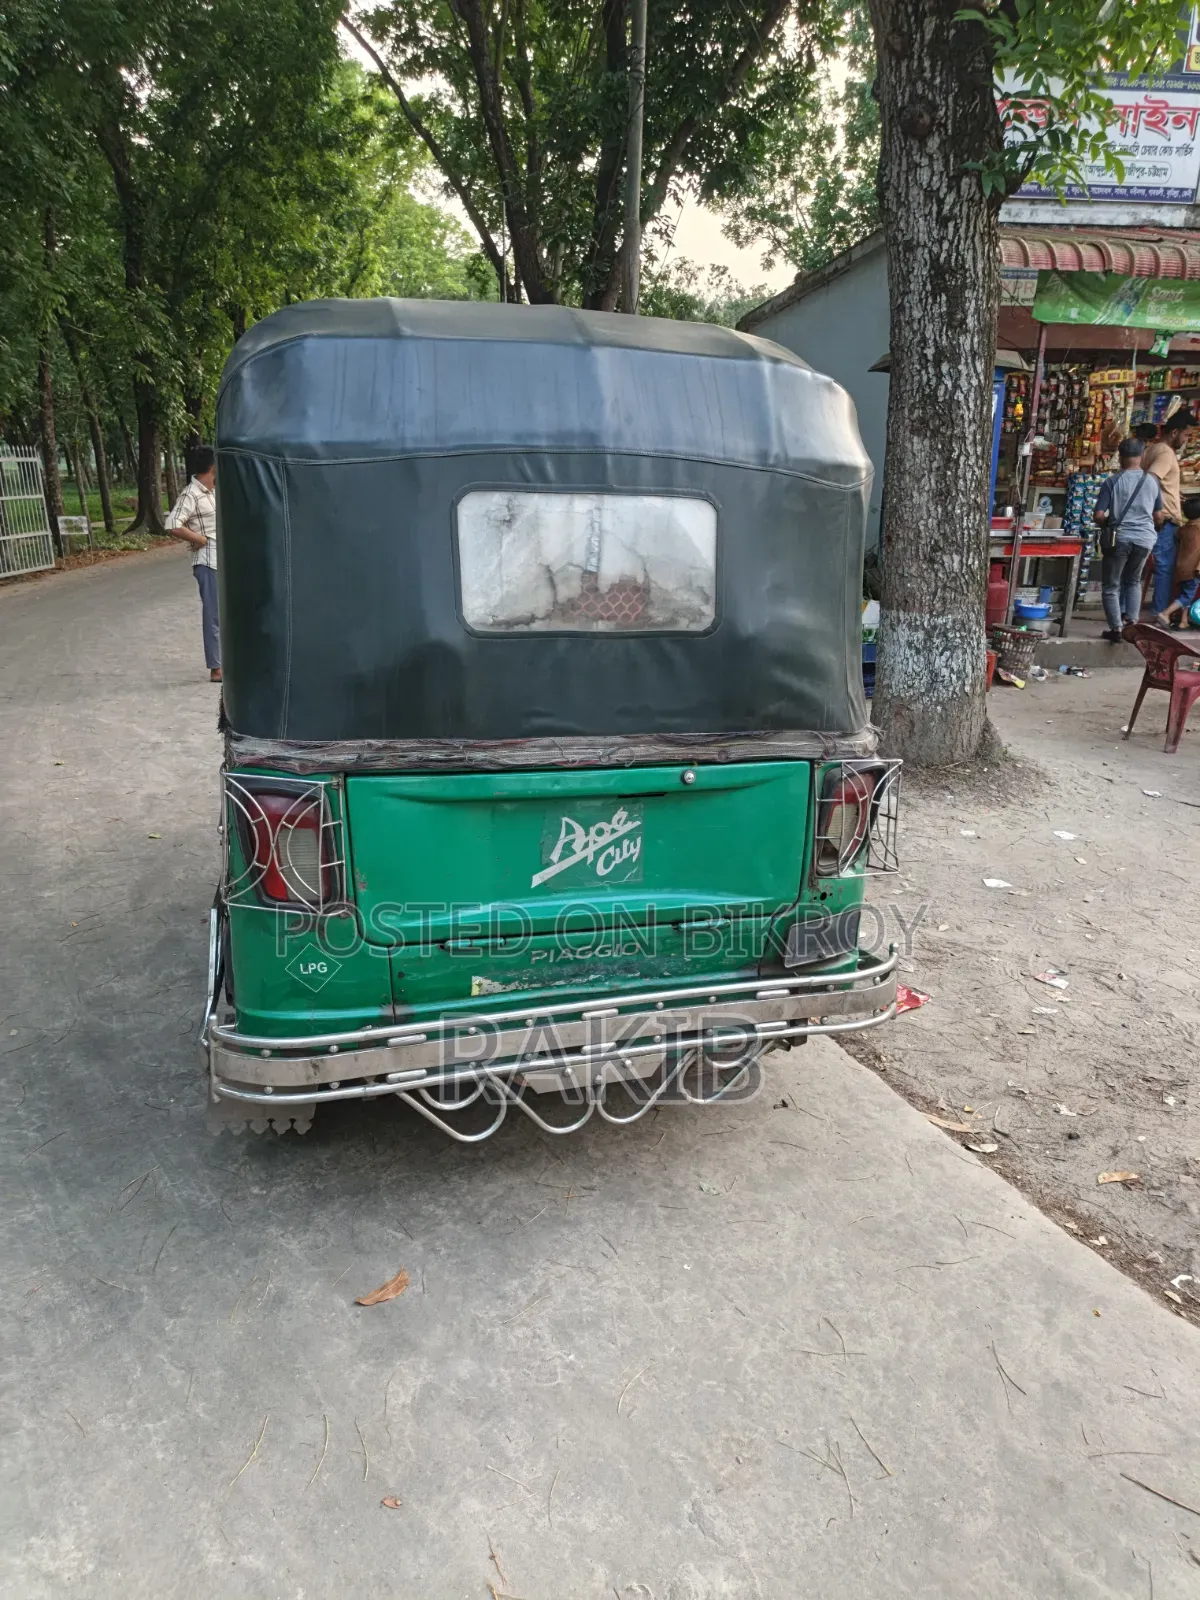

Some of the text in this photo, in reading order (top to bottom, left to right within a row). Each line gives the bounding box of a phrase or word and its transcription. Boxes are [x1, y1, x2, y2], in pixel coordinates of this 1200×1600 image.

[531, 806, 642, 888] Ape
[596, 836, 642, 876] City
[299, 961, 329, 975] LPG
[530, 942, 641, 965] PIAGGIO
